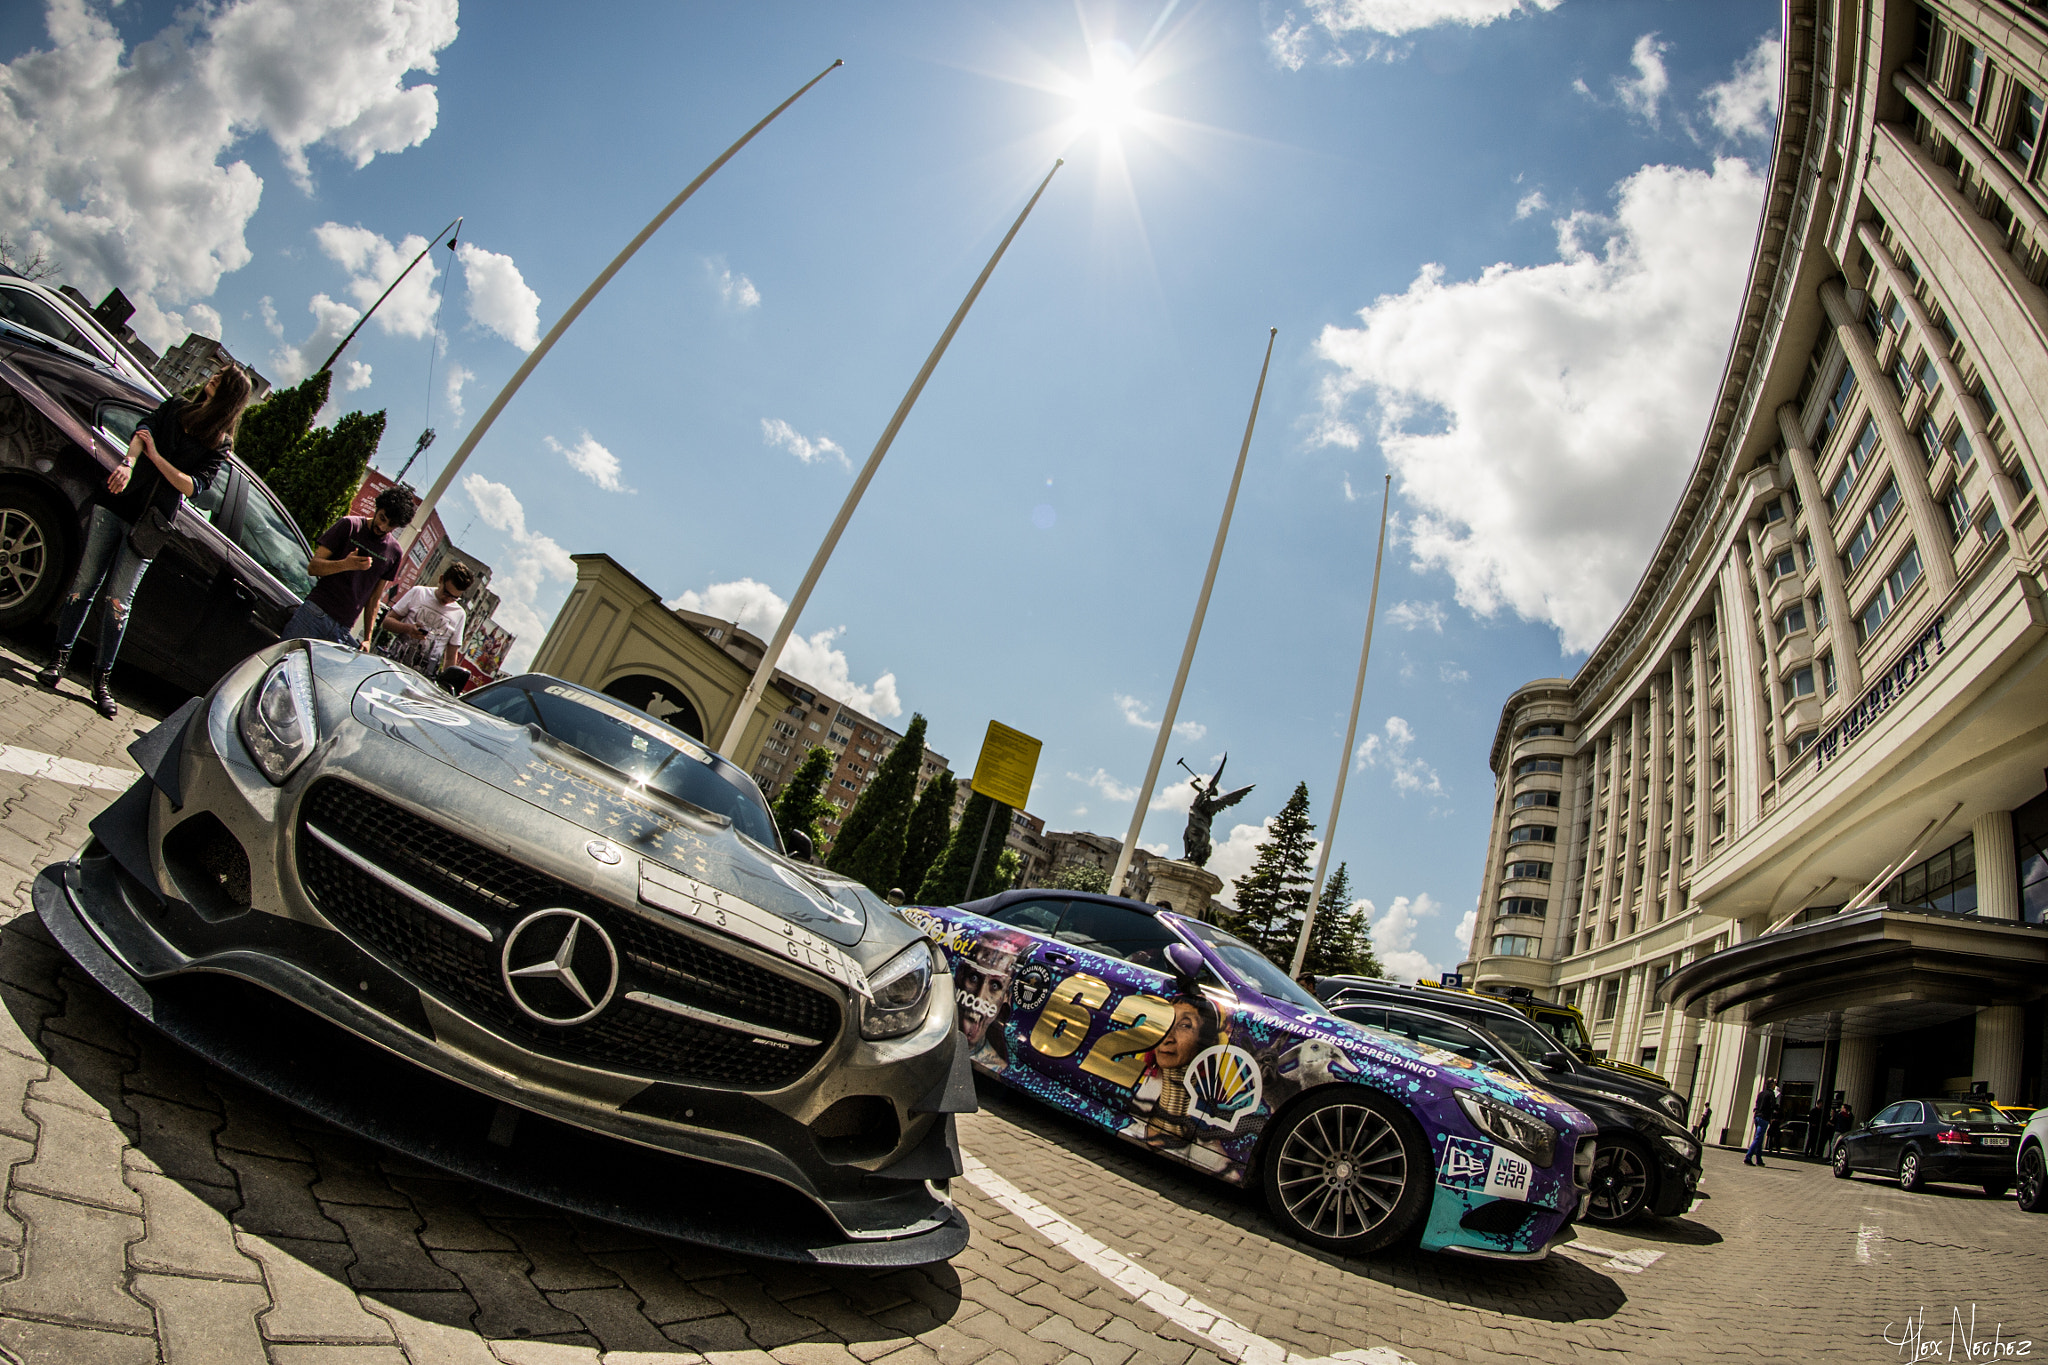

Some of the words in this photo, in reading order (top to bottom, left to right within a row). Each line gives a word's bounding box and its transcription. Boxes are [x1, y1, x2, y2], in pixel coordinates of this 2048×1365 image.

[1842, 617, 1947, 748] MARRIOTT
[526, 759, 708, 848] BUCHAREST
[1021, 964, 1050, 983] GUINNESS
[1445, 976, 1458, 986] P
[1012, 979, 1023, 1006] WORLD
[1022, 988, 1049, 1011] RECORDS
[1029, 972, 1176, 1088] 62
[1252, 1012, 1437, 1079] WWW.MASTERSOFSPEED.INFO
[1493, 1171, 1526, 1190] ERA
[1497, 1157, 1528, 1176] NEW
